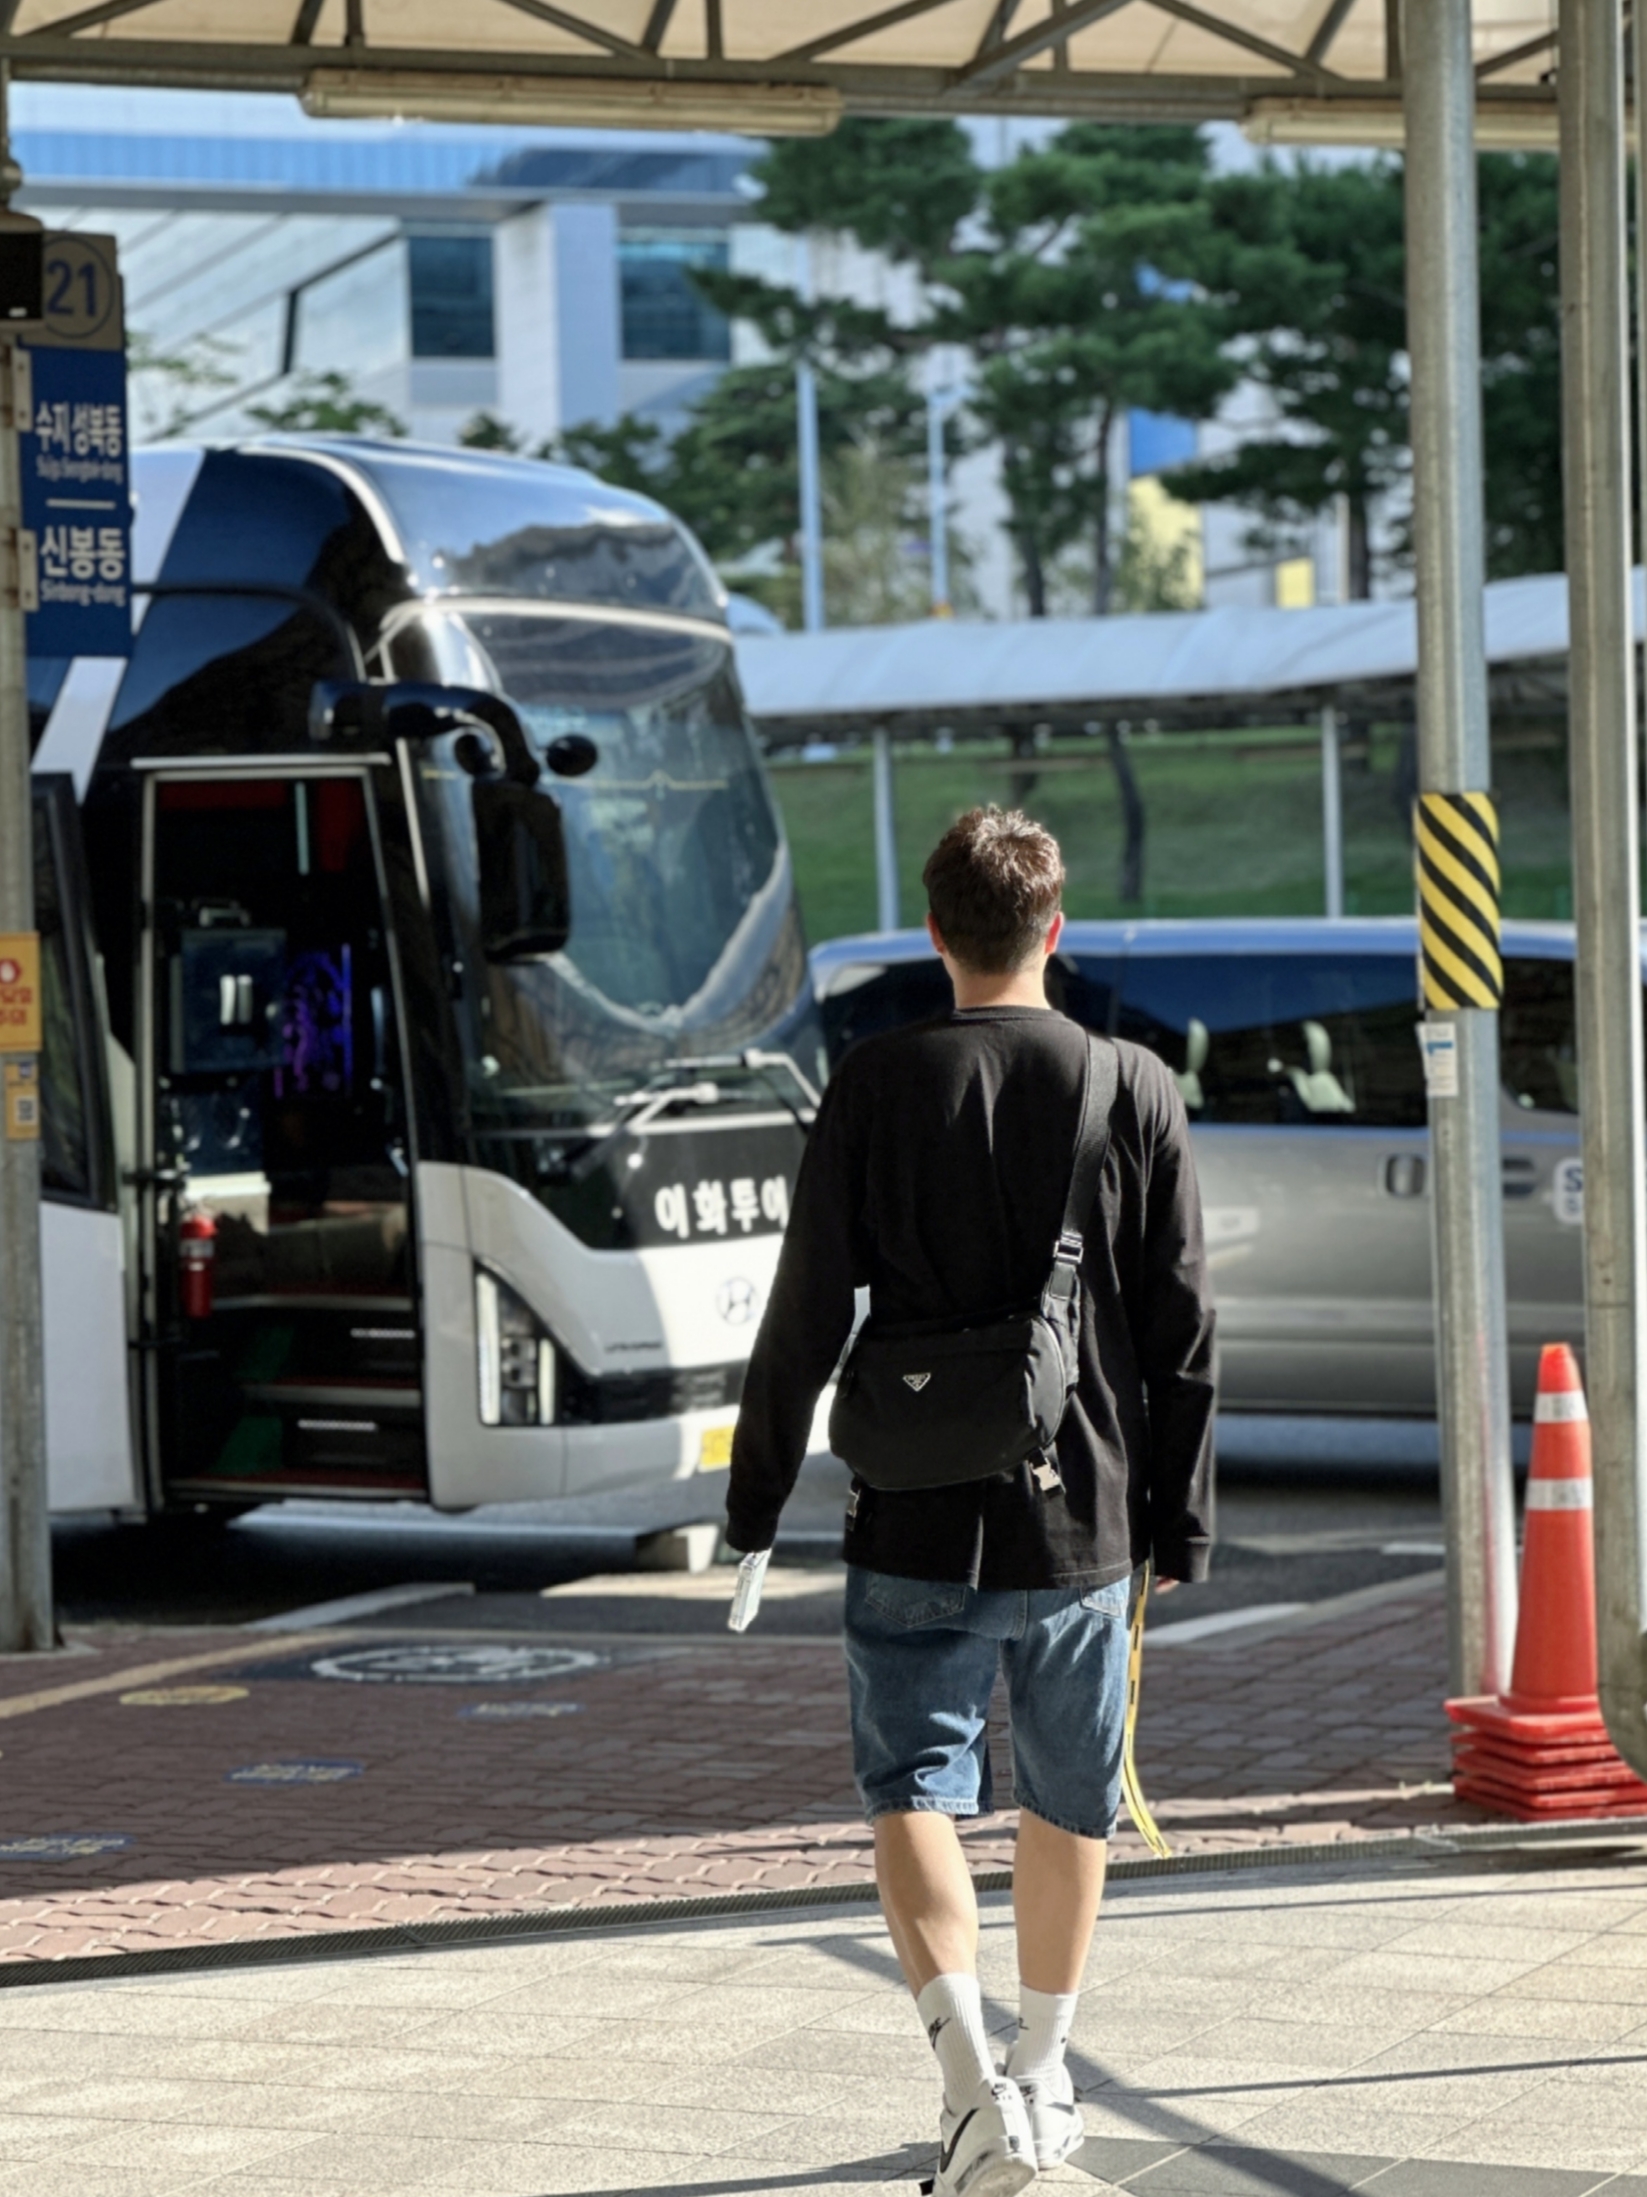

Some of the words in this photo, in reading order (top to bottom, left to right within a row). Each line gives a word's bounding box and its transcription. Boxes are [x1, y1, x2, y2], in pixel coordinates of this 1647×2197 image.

[46, 257, 97, 318] 21
[35, 400, 71, 454] 수지
[40, 525, 126, 582] 신봉동
[1564, 1166, 1583, 1193] S
